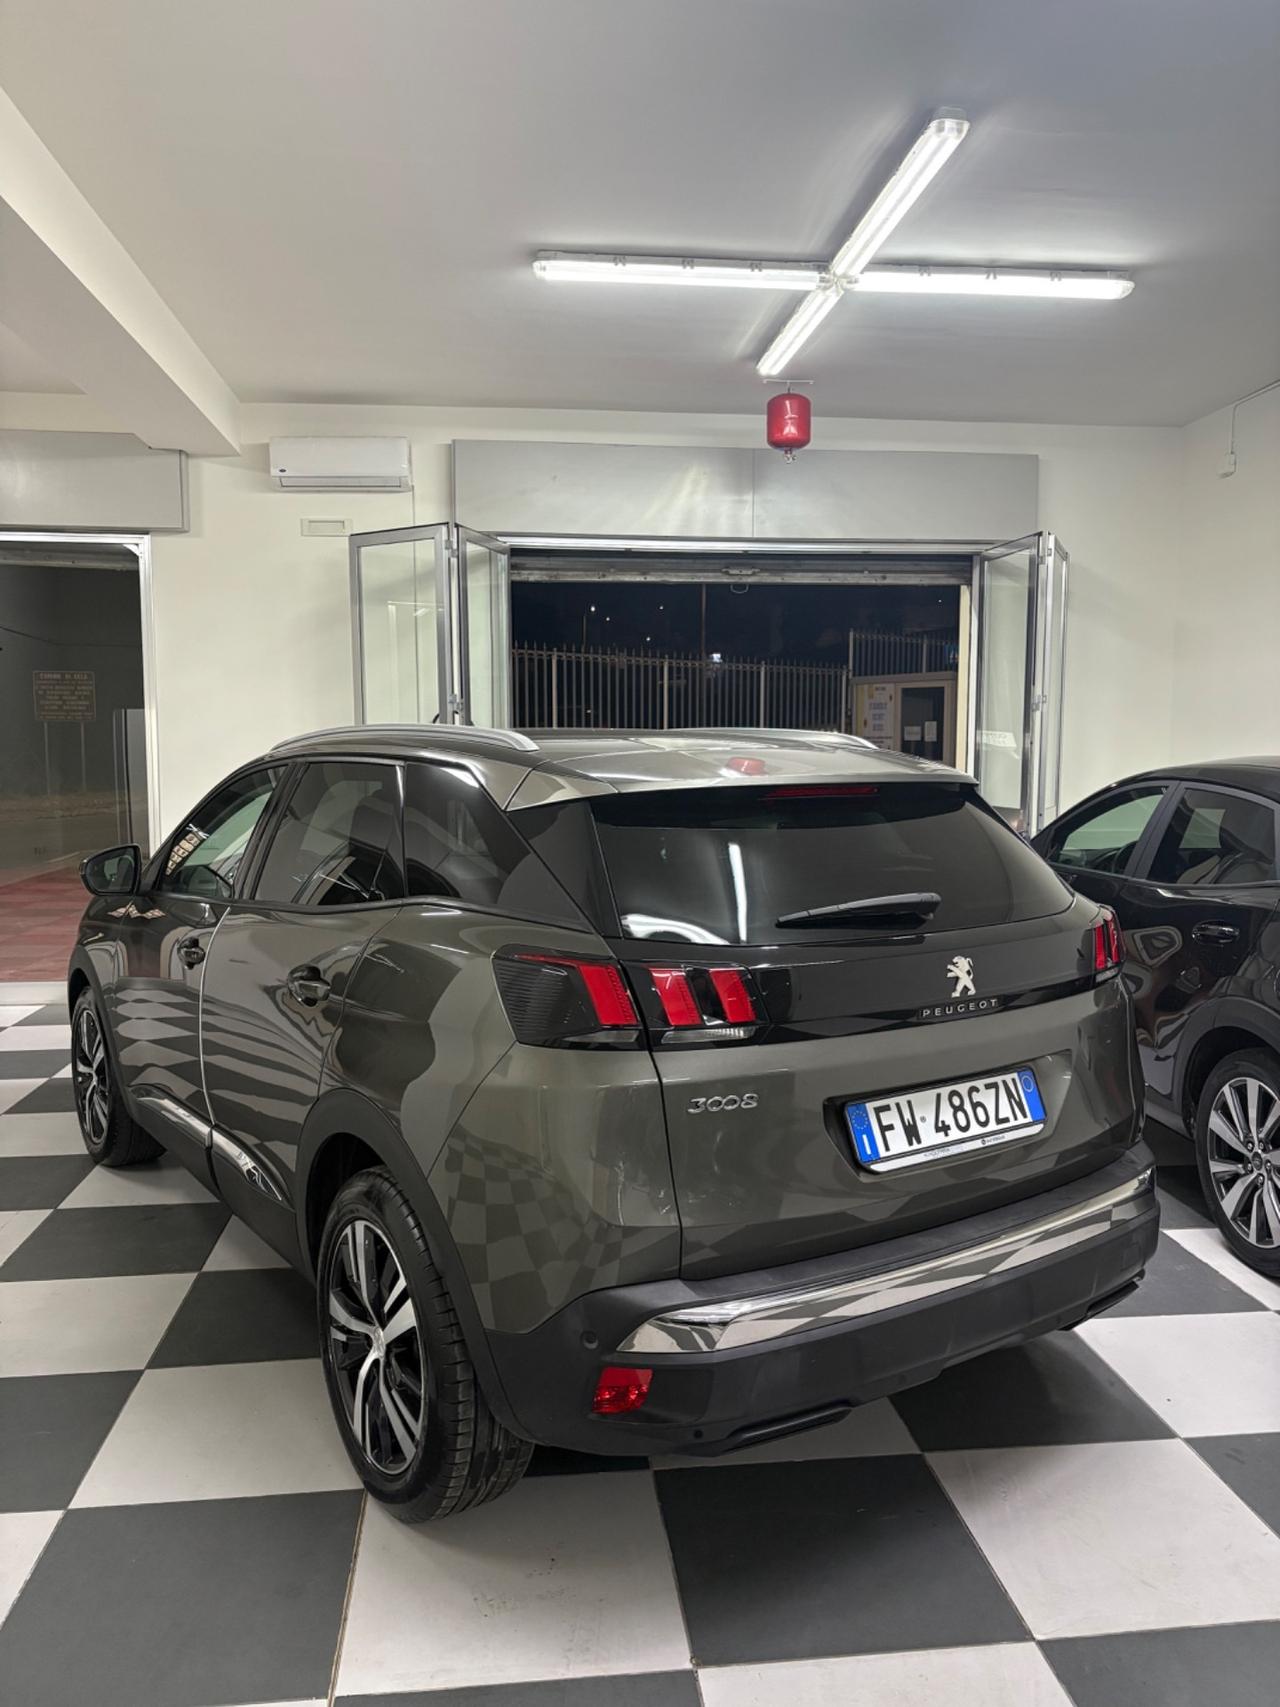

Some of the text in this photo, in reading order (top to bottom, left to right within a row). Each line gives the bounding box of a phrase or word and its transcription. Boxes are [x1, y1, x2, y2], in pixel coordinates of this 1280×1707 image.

[922, 999, 998, 1017] PEUGEOT
[687, 1093, 759, 1113] 3008
[873, 1099, 922, 1153] FW
[933, 1077, 1029, 1138] 486ZN
